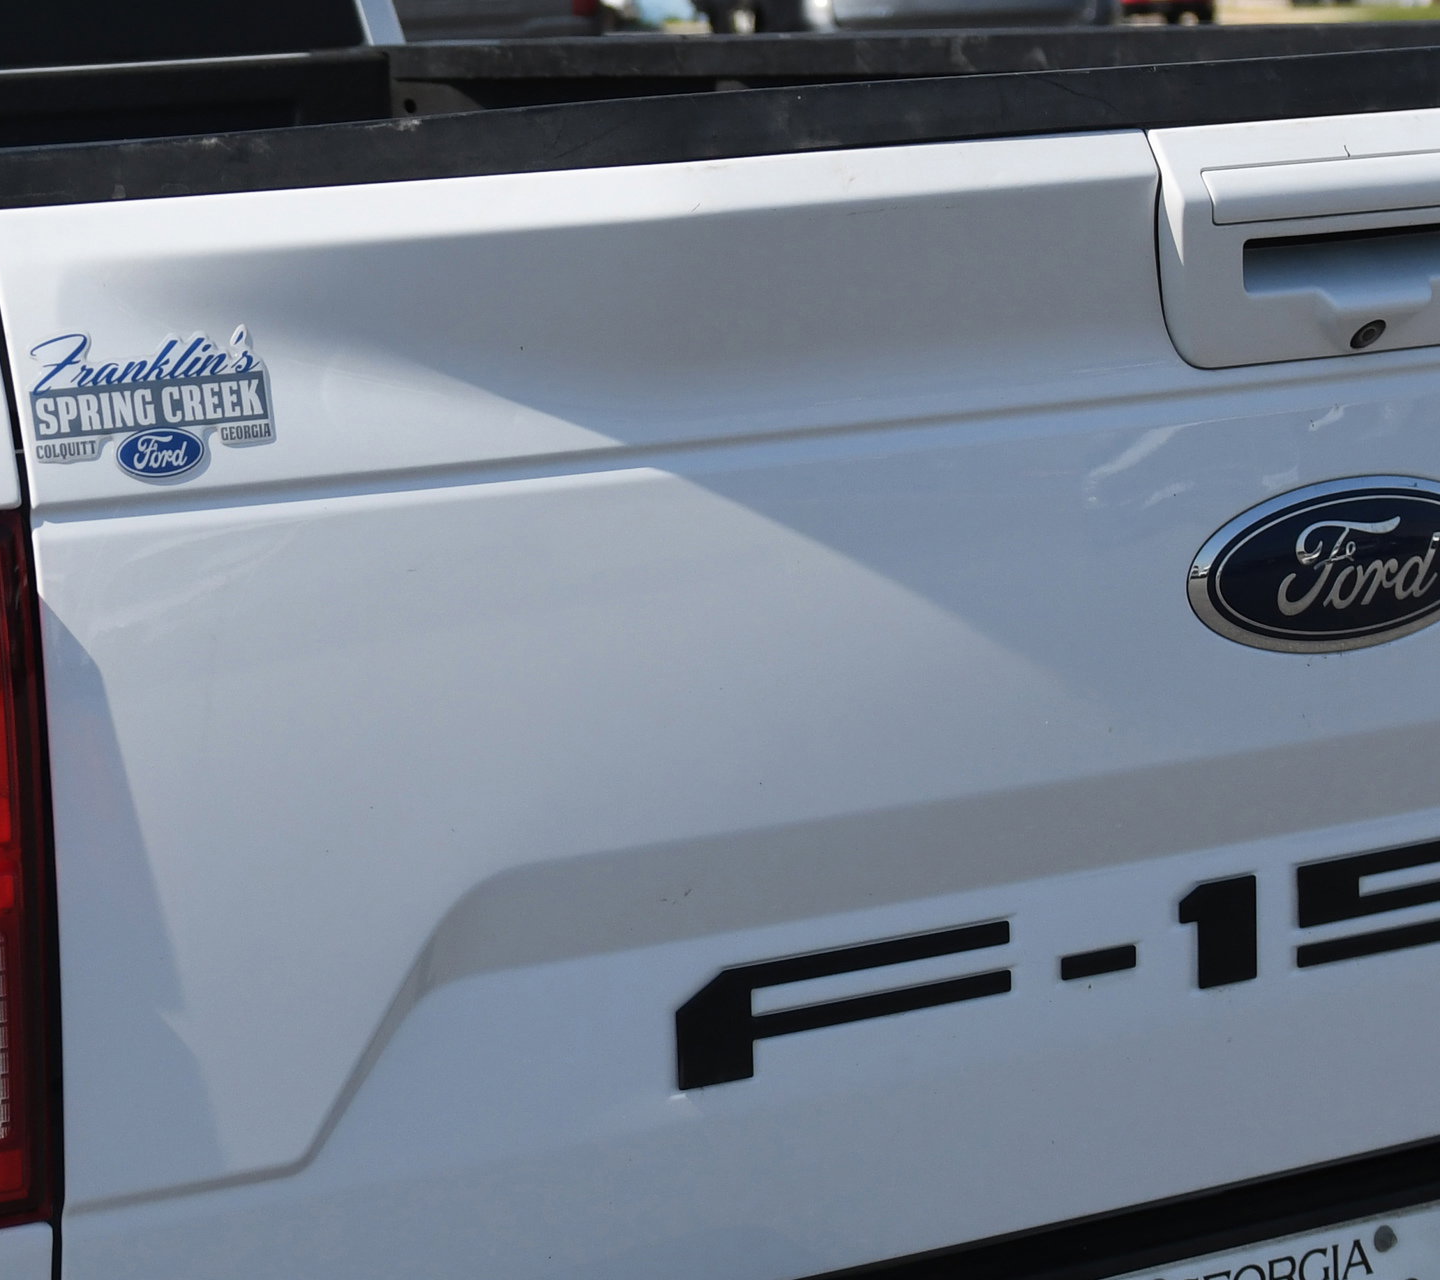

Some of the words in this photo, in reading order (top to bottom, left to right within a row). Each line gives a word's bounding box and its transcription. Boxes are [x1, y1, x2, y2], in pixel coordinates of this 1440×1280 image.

[30, 330, 260, 394] Franklin's
[35, 390, 156, 435] SPRING
[161, 379, 264, 423] CREEK
[221, 422, 271, 442] GEORGIA
[36, 440, 96, 460] COLQUITT
[132, 435, 188, 470] Ford
